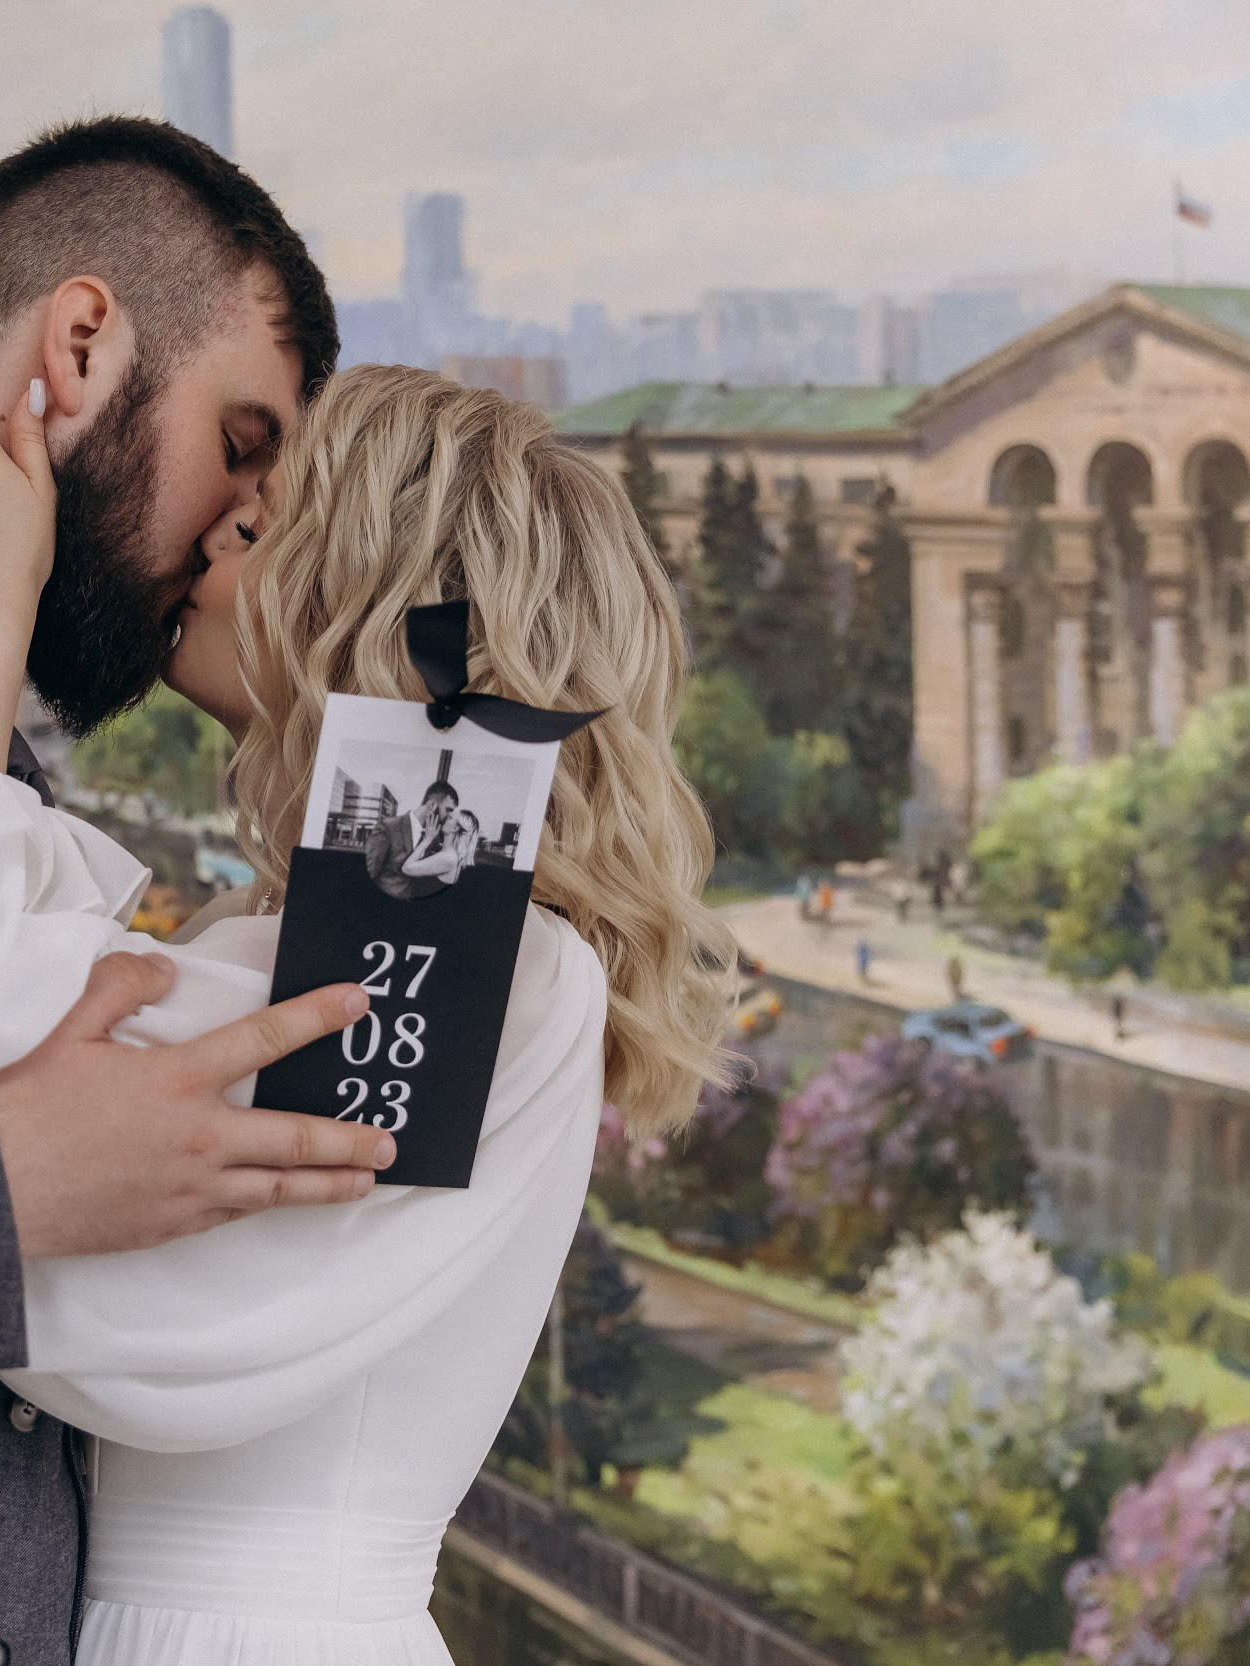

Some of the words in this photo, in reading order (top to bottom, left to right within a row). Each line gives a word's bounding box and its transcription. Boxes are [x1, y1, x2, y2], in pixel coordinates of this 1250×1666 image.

[359, 941, 437, 998] 27
[342, 1009, 426, 1068] 08
[335, 1077, 411, 1132] 23
